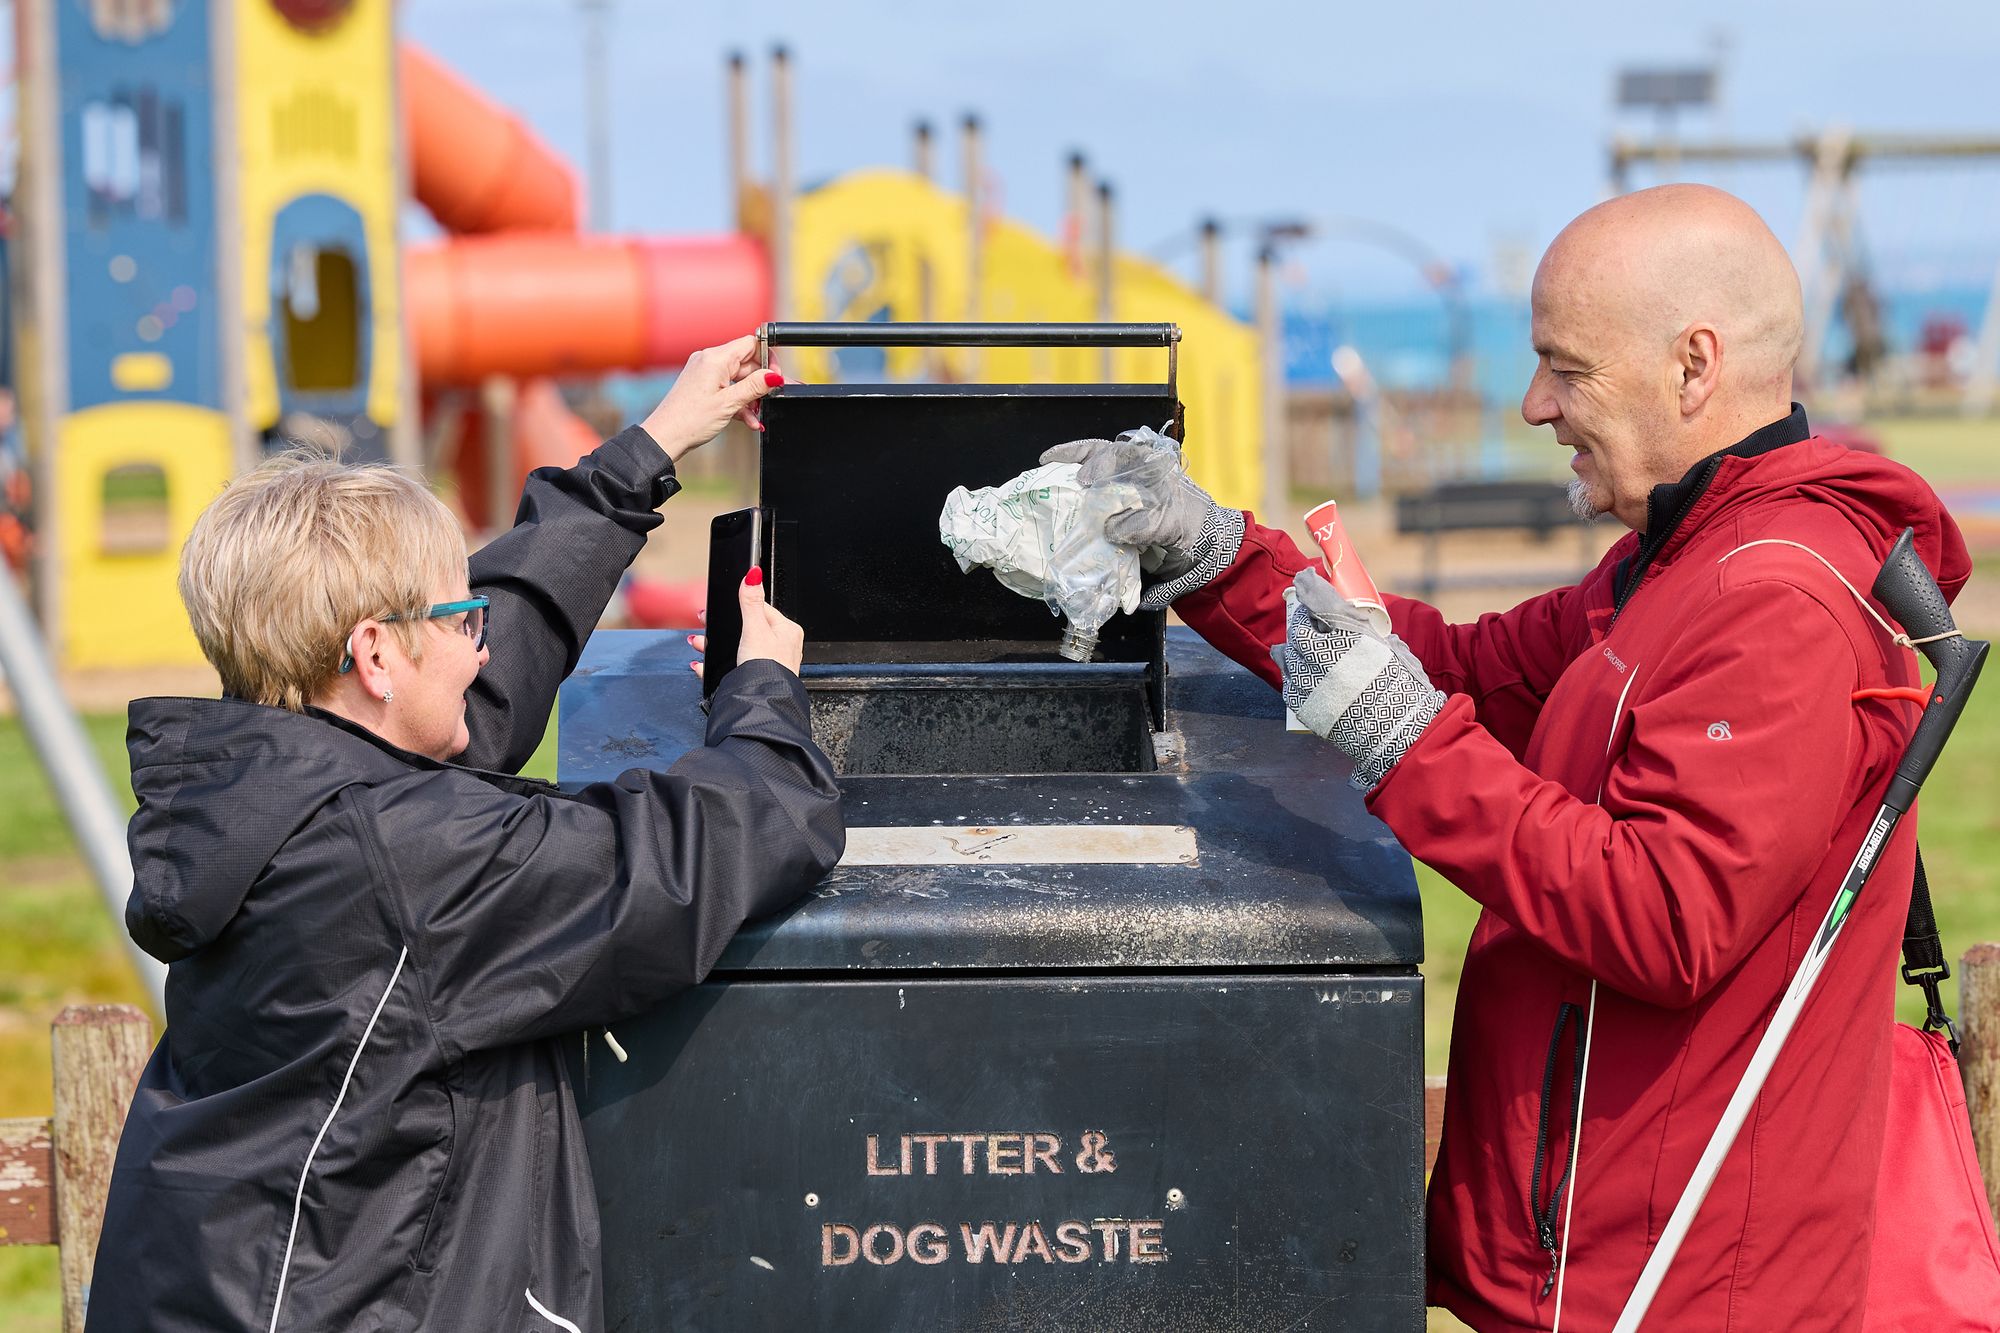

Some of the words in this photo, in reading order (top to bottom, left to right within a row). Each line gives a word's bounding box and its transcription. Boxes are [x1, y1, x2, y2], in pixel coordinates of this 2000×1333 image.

[866, 1131, 1064, 1177] LITTER
[1076, 1130, 1118, 1174] &
[821, 1220, 950, 1266] DOG
[960, 1218, 1168, 1265] WASTE
